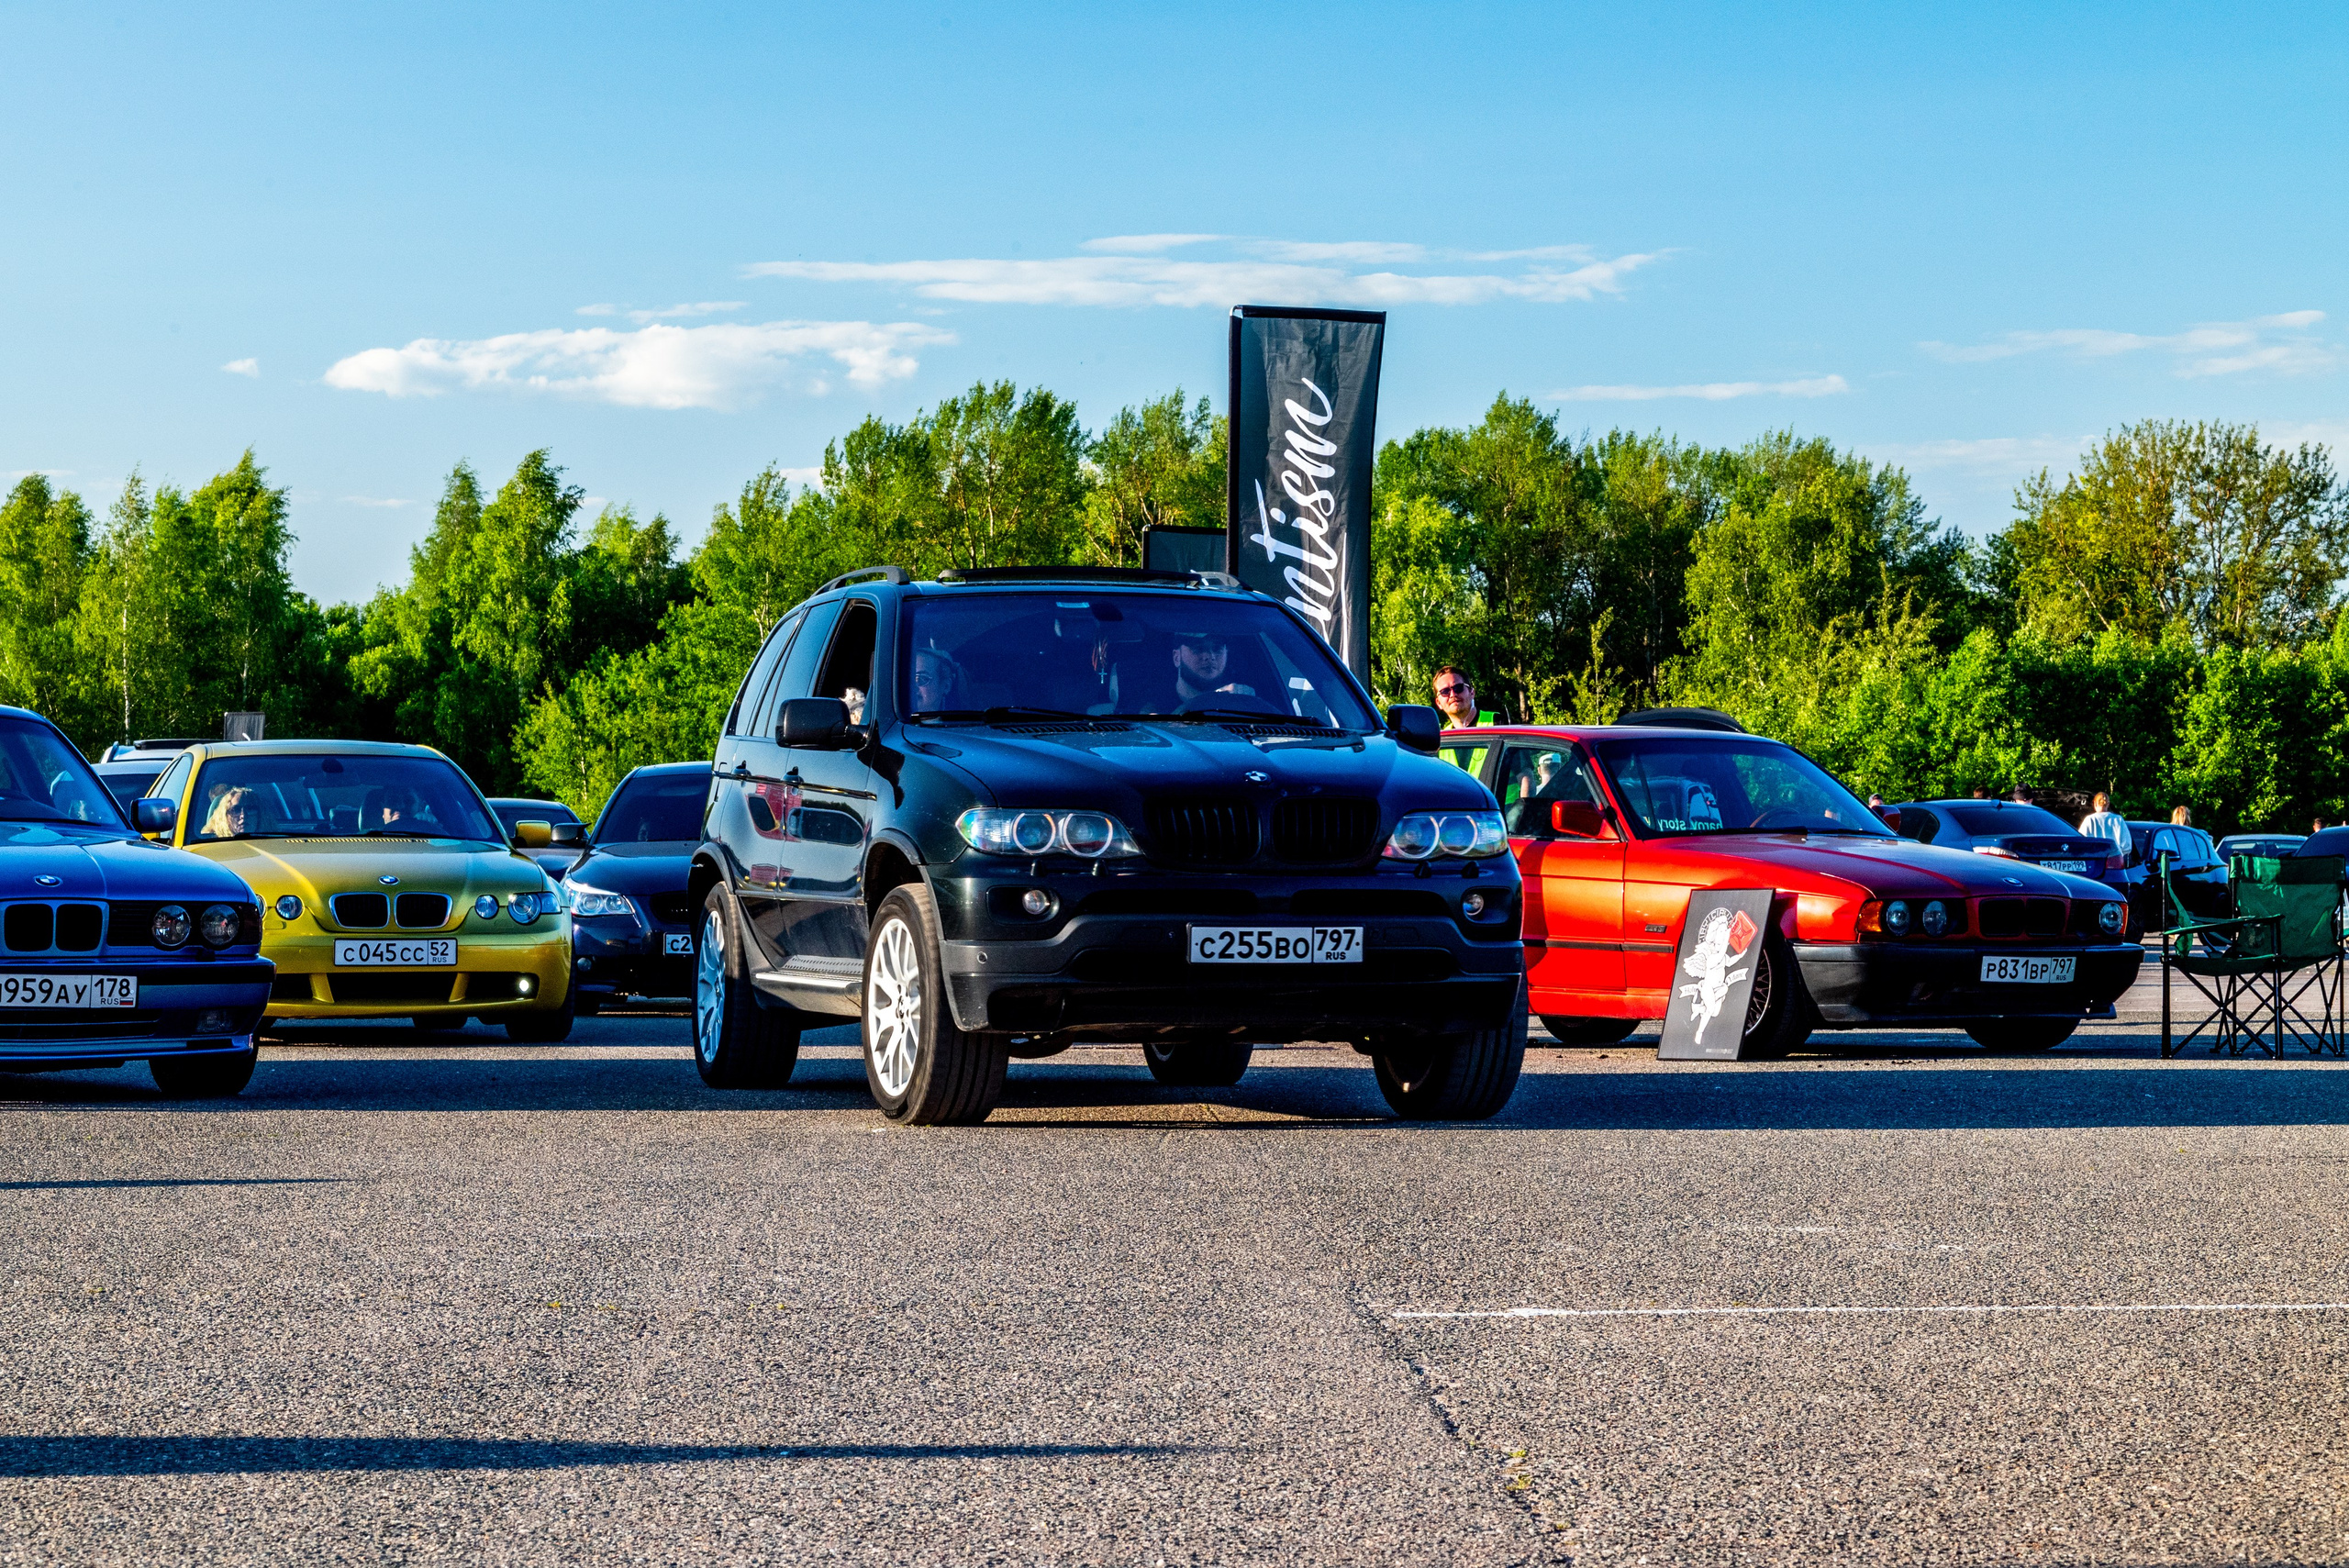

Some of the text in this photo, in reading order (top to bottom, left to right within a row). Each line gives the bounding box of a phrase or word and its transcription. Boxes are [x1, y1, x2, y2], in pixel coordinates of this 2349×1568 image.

[1251, 377, 1339, 644] ntism
[343, 941, 449, 962] С045СС 52
[670, 936, 691, 952] С2
[1199, 929, 1356, 959] С255ВО 797
[1325, 951, 1346, 961] RUS
[1987, 959, 2073, 980] Р831ВР 797
[0, 978, 130, 1004] 959АУ 178
[100, 997, 119, 1006] RUS
